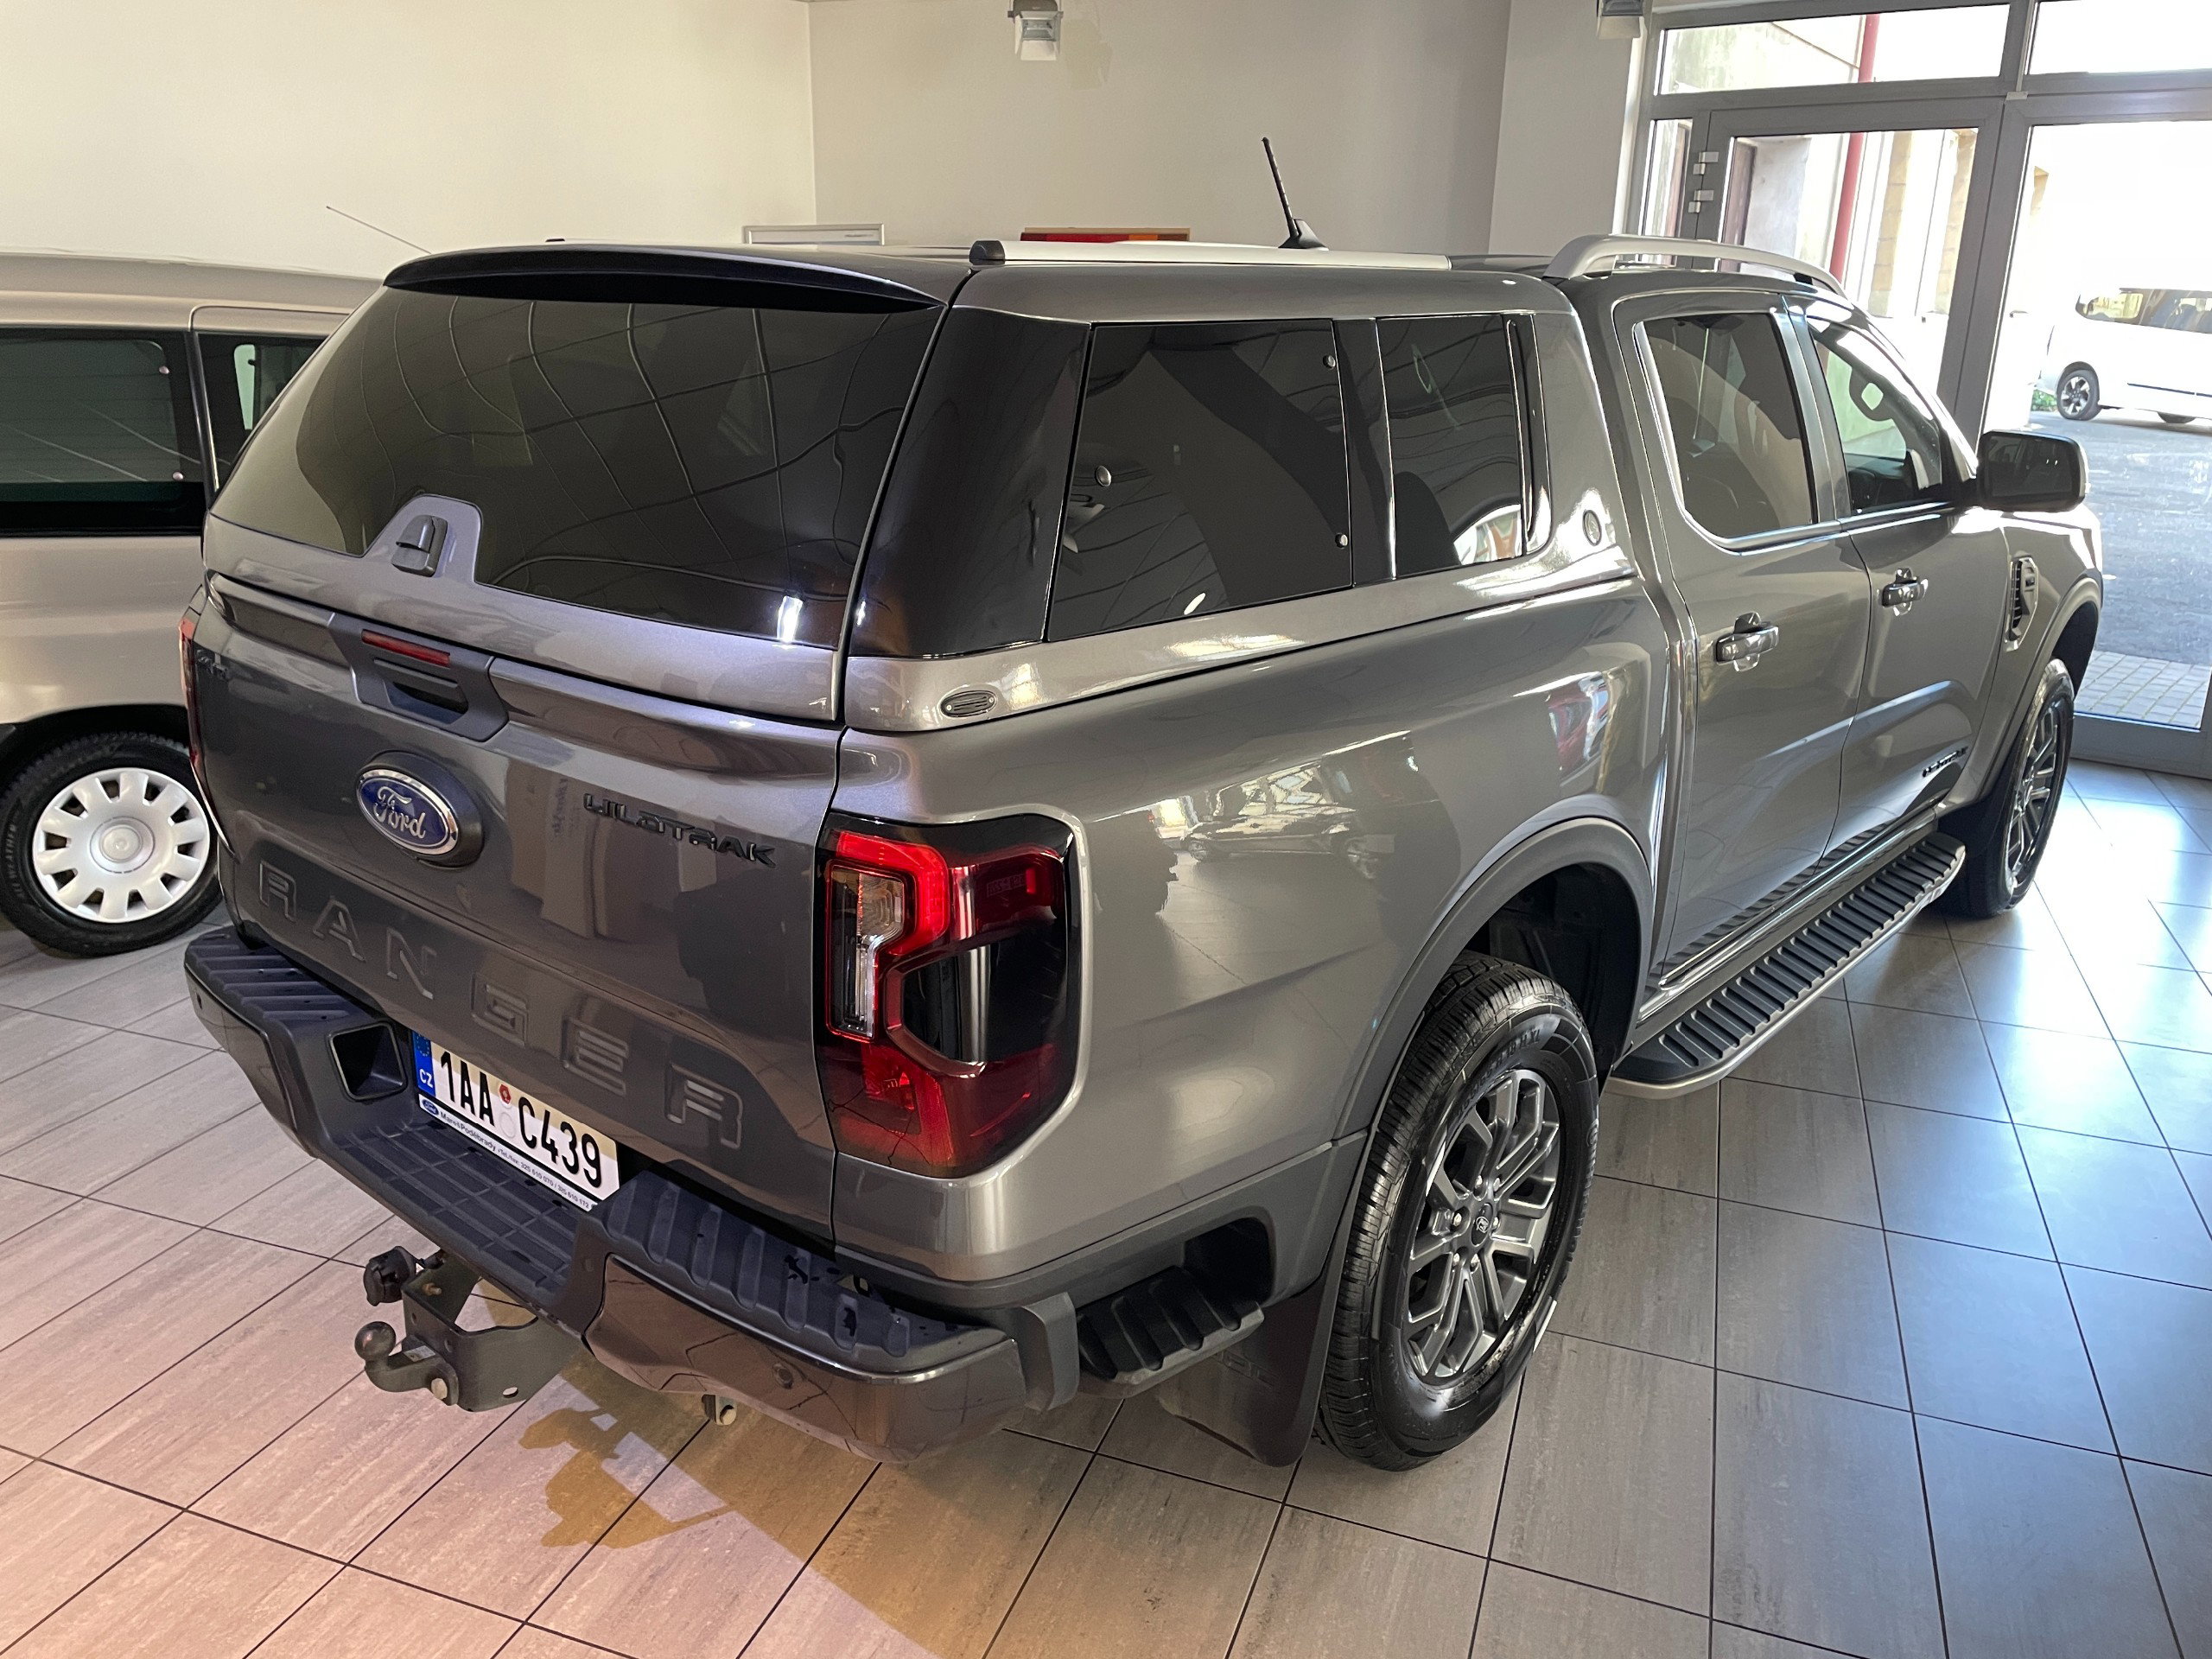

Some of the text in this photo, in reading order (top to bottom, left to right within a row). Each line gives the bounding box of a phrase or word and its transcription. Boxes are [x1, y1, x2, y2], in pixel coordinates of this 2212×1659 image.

[372, 786, 427, 839] Ford
[584, 792, 777, 868] WILDTRAK
[259, 863, 744, 1151] RANGER
[419, 1068, 434, 1089] CZ
[441, 1051, 602, 1188] 1AA C439
